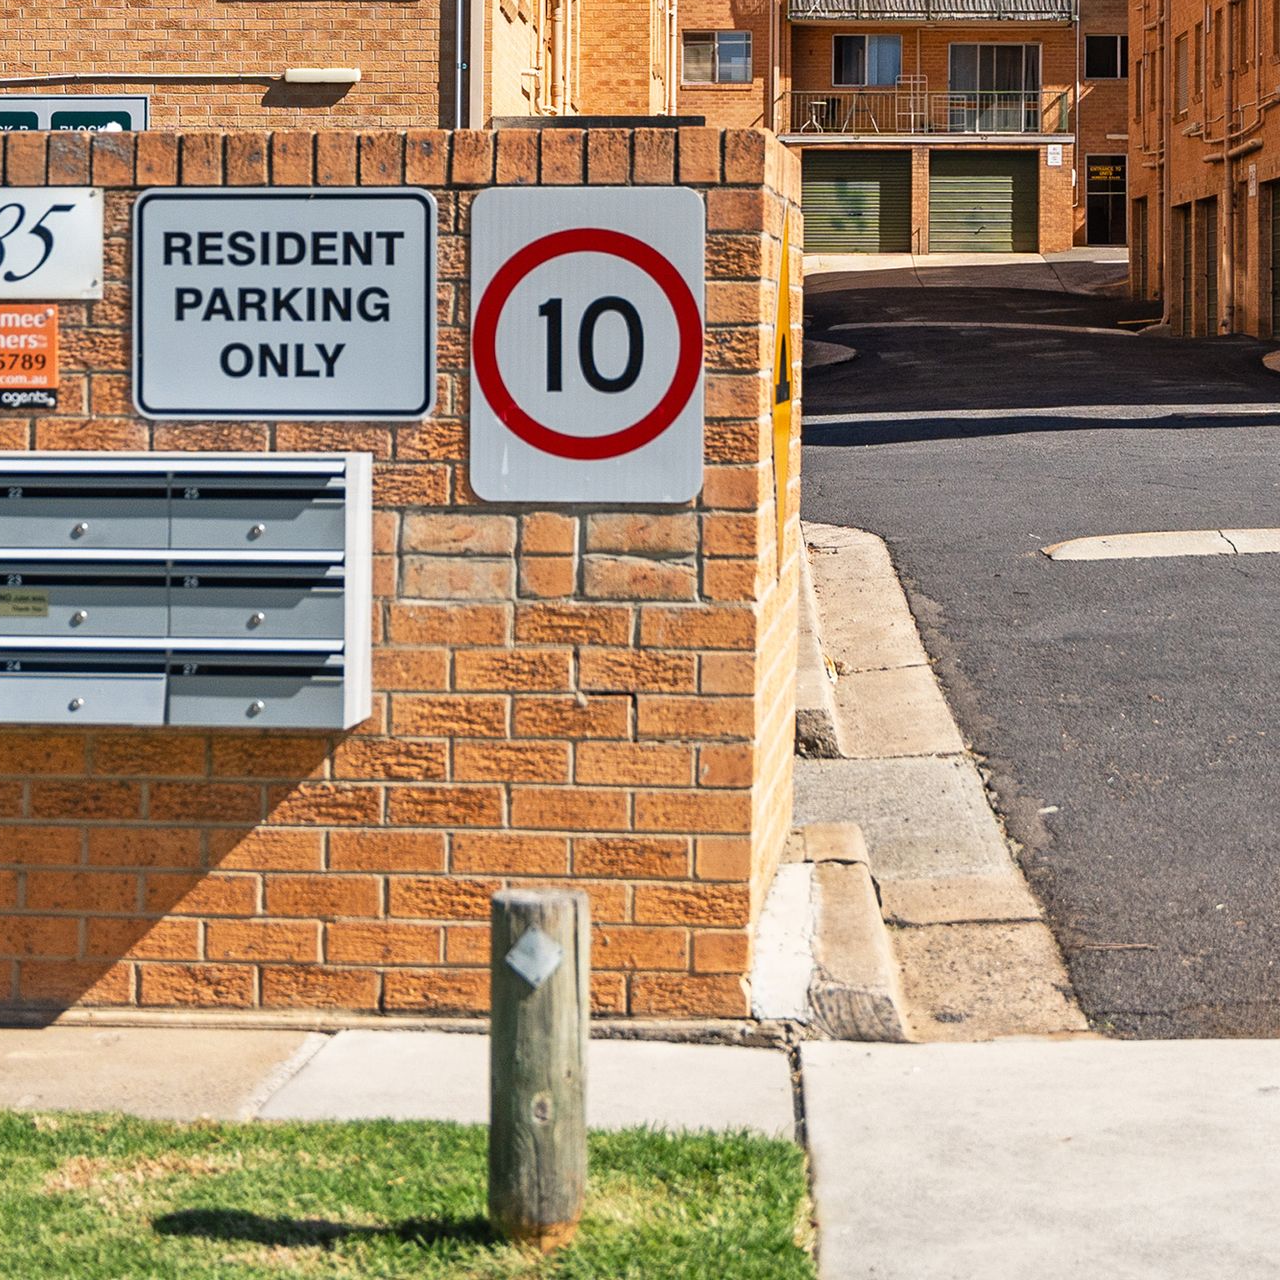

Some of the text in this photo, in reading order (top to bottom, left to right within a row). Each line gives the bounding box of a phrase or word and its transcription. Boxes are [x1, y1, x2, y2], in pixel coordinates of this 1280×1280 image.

[163, 230, 405, 267] RESIDENT
[175, 286, 390, 323] PARKING
[219, 342, 346, 378] ONLY
[538, 295, 645, 394] 10
[1, 390, 49, 407] agents
[9, 487, 22, 498] 22
[7, 660, 21, 671] 24
